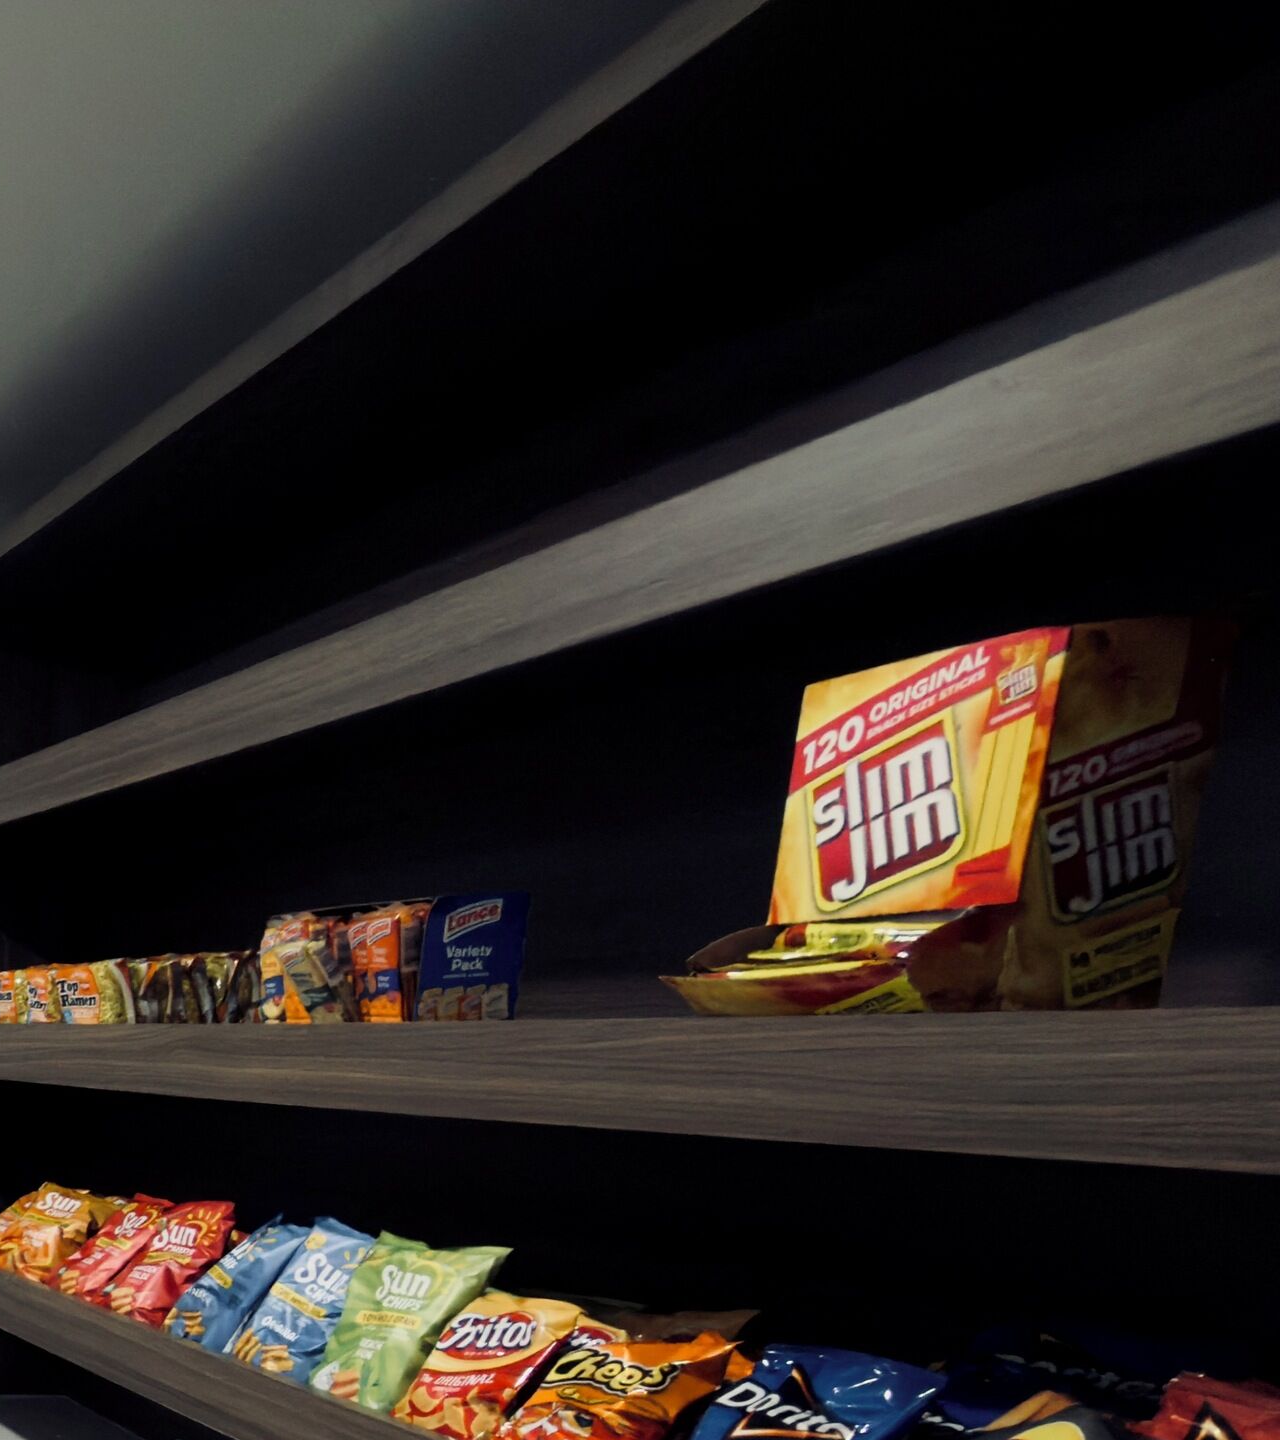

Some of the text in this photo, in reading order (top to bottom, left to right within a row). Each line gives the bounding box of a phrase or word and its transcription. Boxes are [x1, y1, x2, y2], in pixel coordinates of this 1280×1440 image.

[802, 647, 990, 775] 120 ORIGINAL
[1049, 754, 1108, 797] 120
[447, 903, 501, 932] Lance
[446, 945, 493, 959] Variety
[451, 958, 484, 972] Pack
[56, 980, 78, 993] Top
[61, 995, 97, 1007] Ramen
[36, 1191, 82, 1212] Sun
[153, 1219, 198, 1249] Sun
[376, 1264, 432, 1303] Sun
[382, 1295, 421, 1311] CHIPS
[435, 1311, 537, 1350] Fritos
[434, 1373, 495, 1386] ORIGINAL
